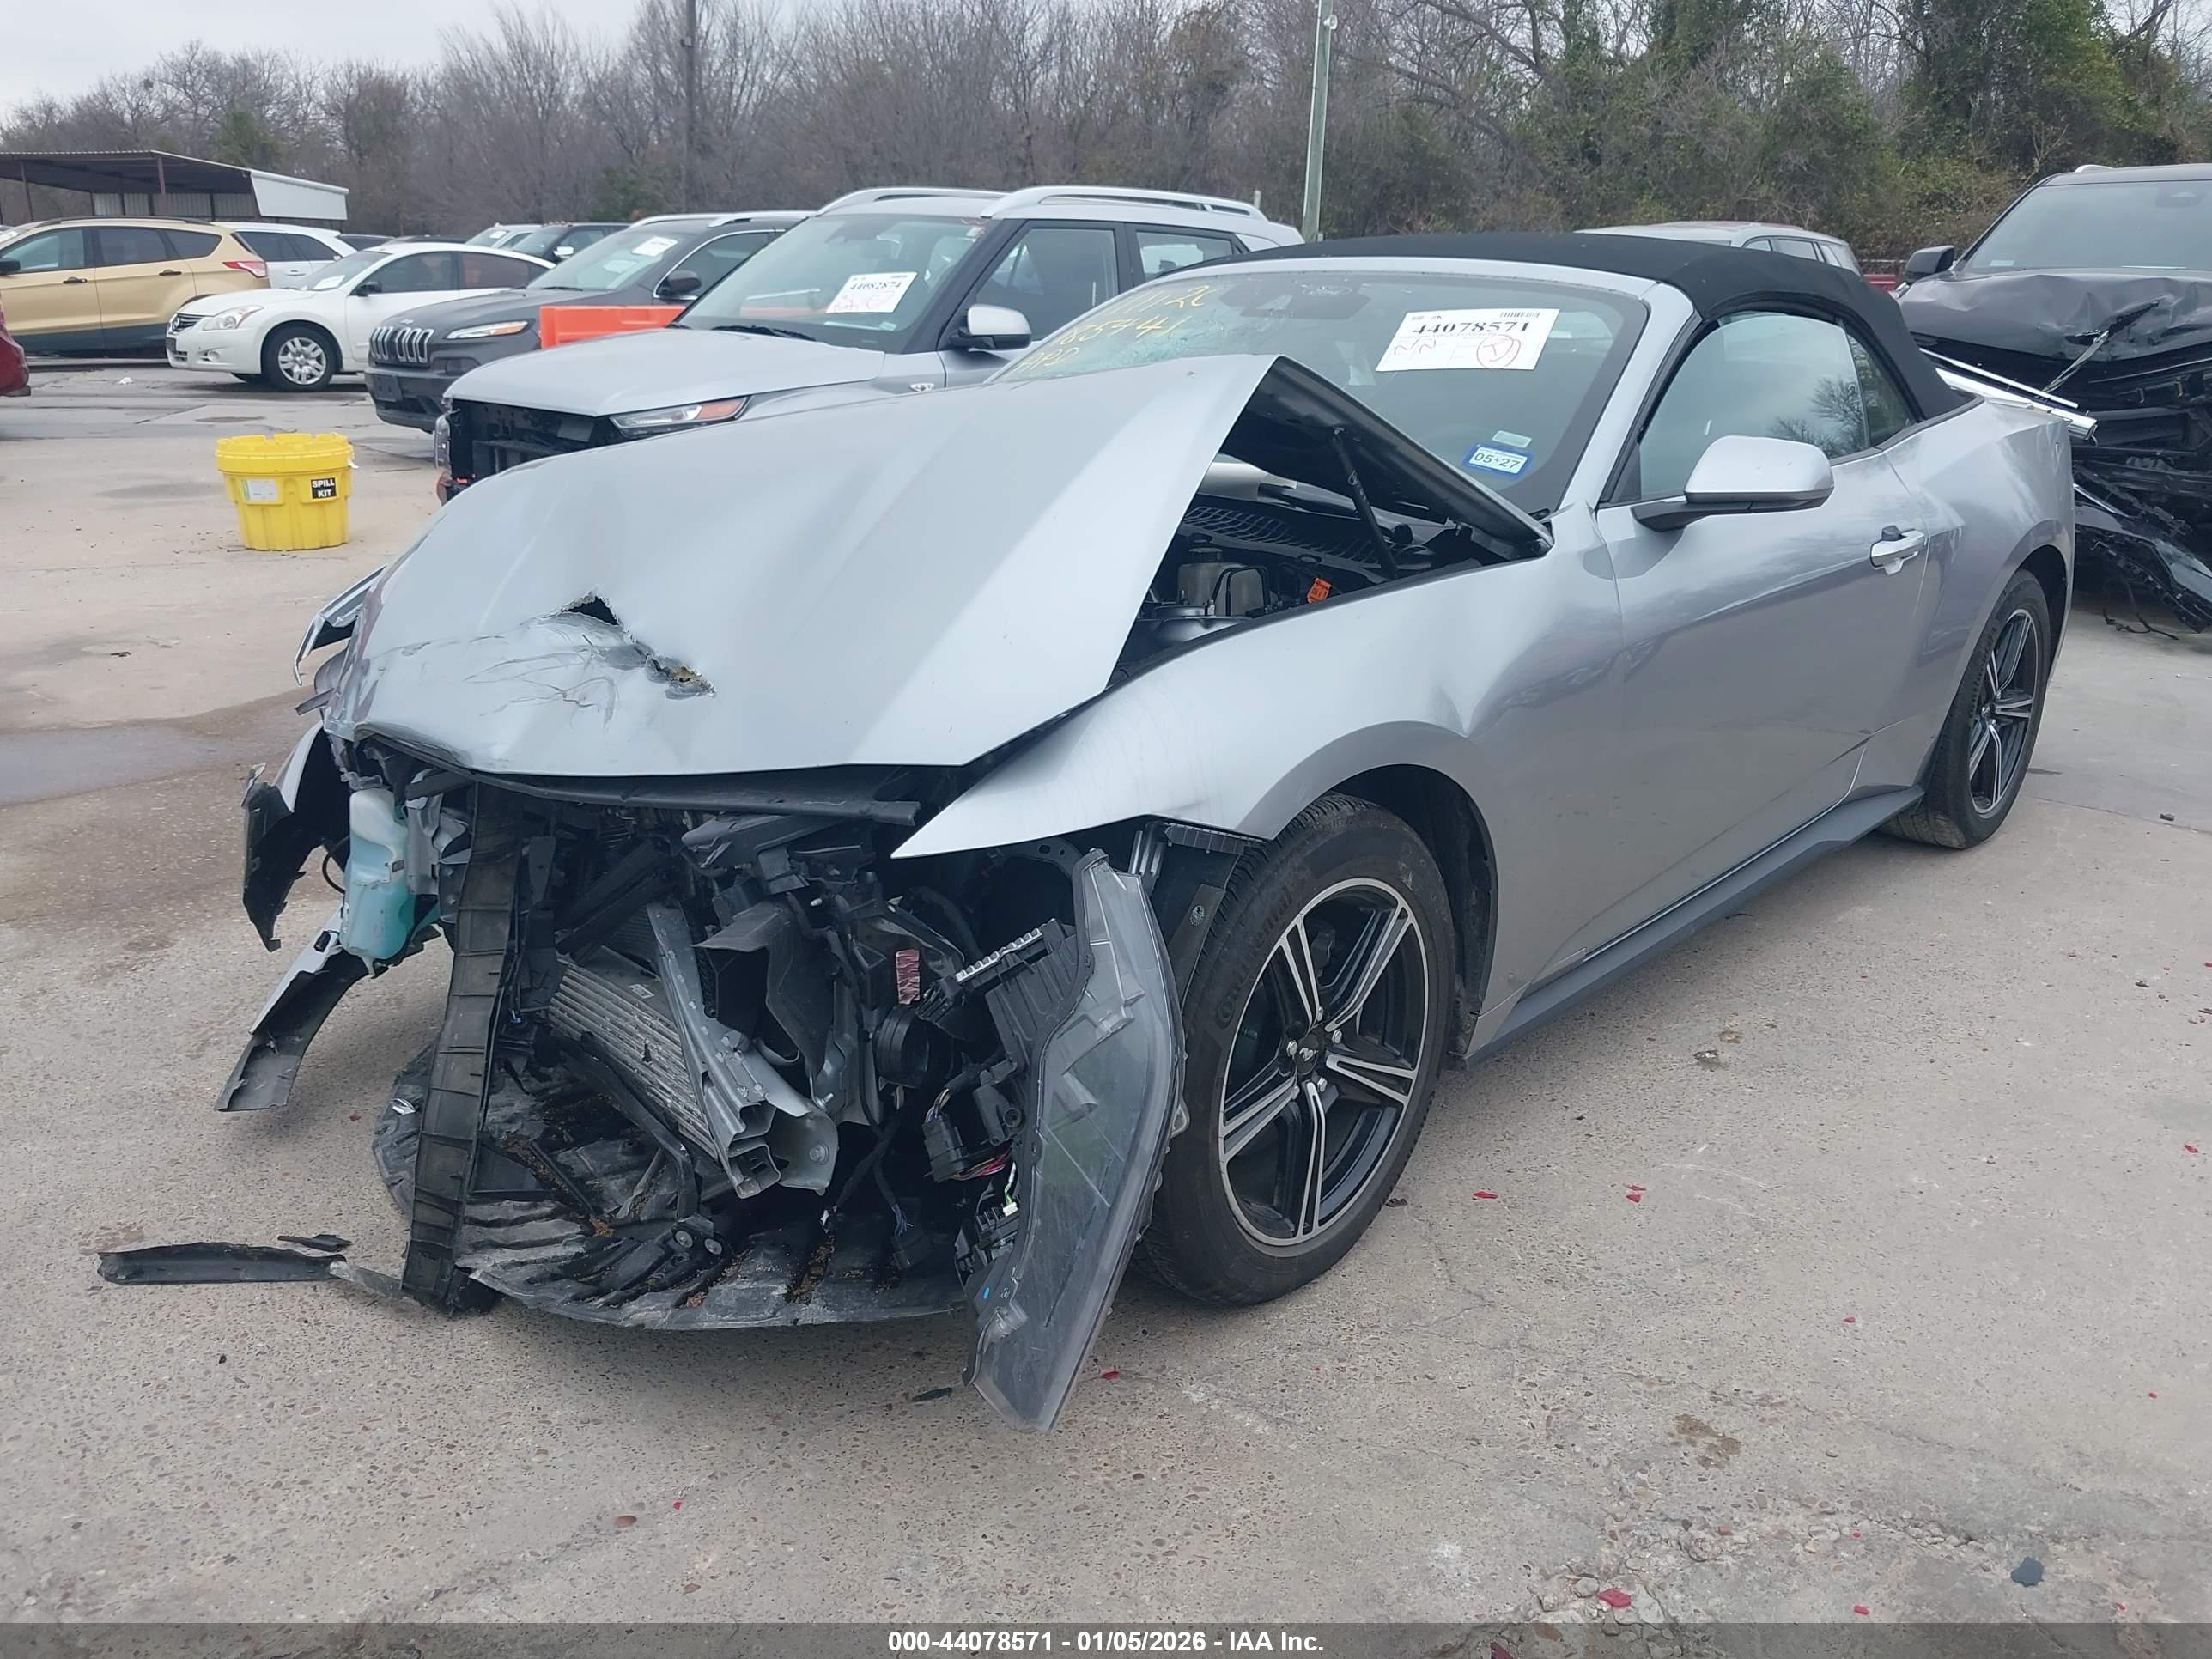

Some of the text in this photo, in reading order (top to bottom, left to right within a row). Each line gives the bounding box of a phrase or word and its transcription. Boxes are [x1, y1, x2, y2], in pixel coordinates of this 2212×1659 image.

[1413, 321, 1530, 335] 44078571
[1474, 453, 1494, 464] 05
[1498, 458, 1521, 469] 27
[312, 479, 335, 489] SPILL
[317, 488, 334, 499] KIT
